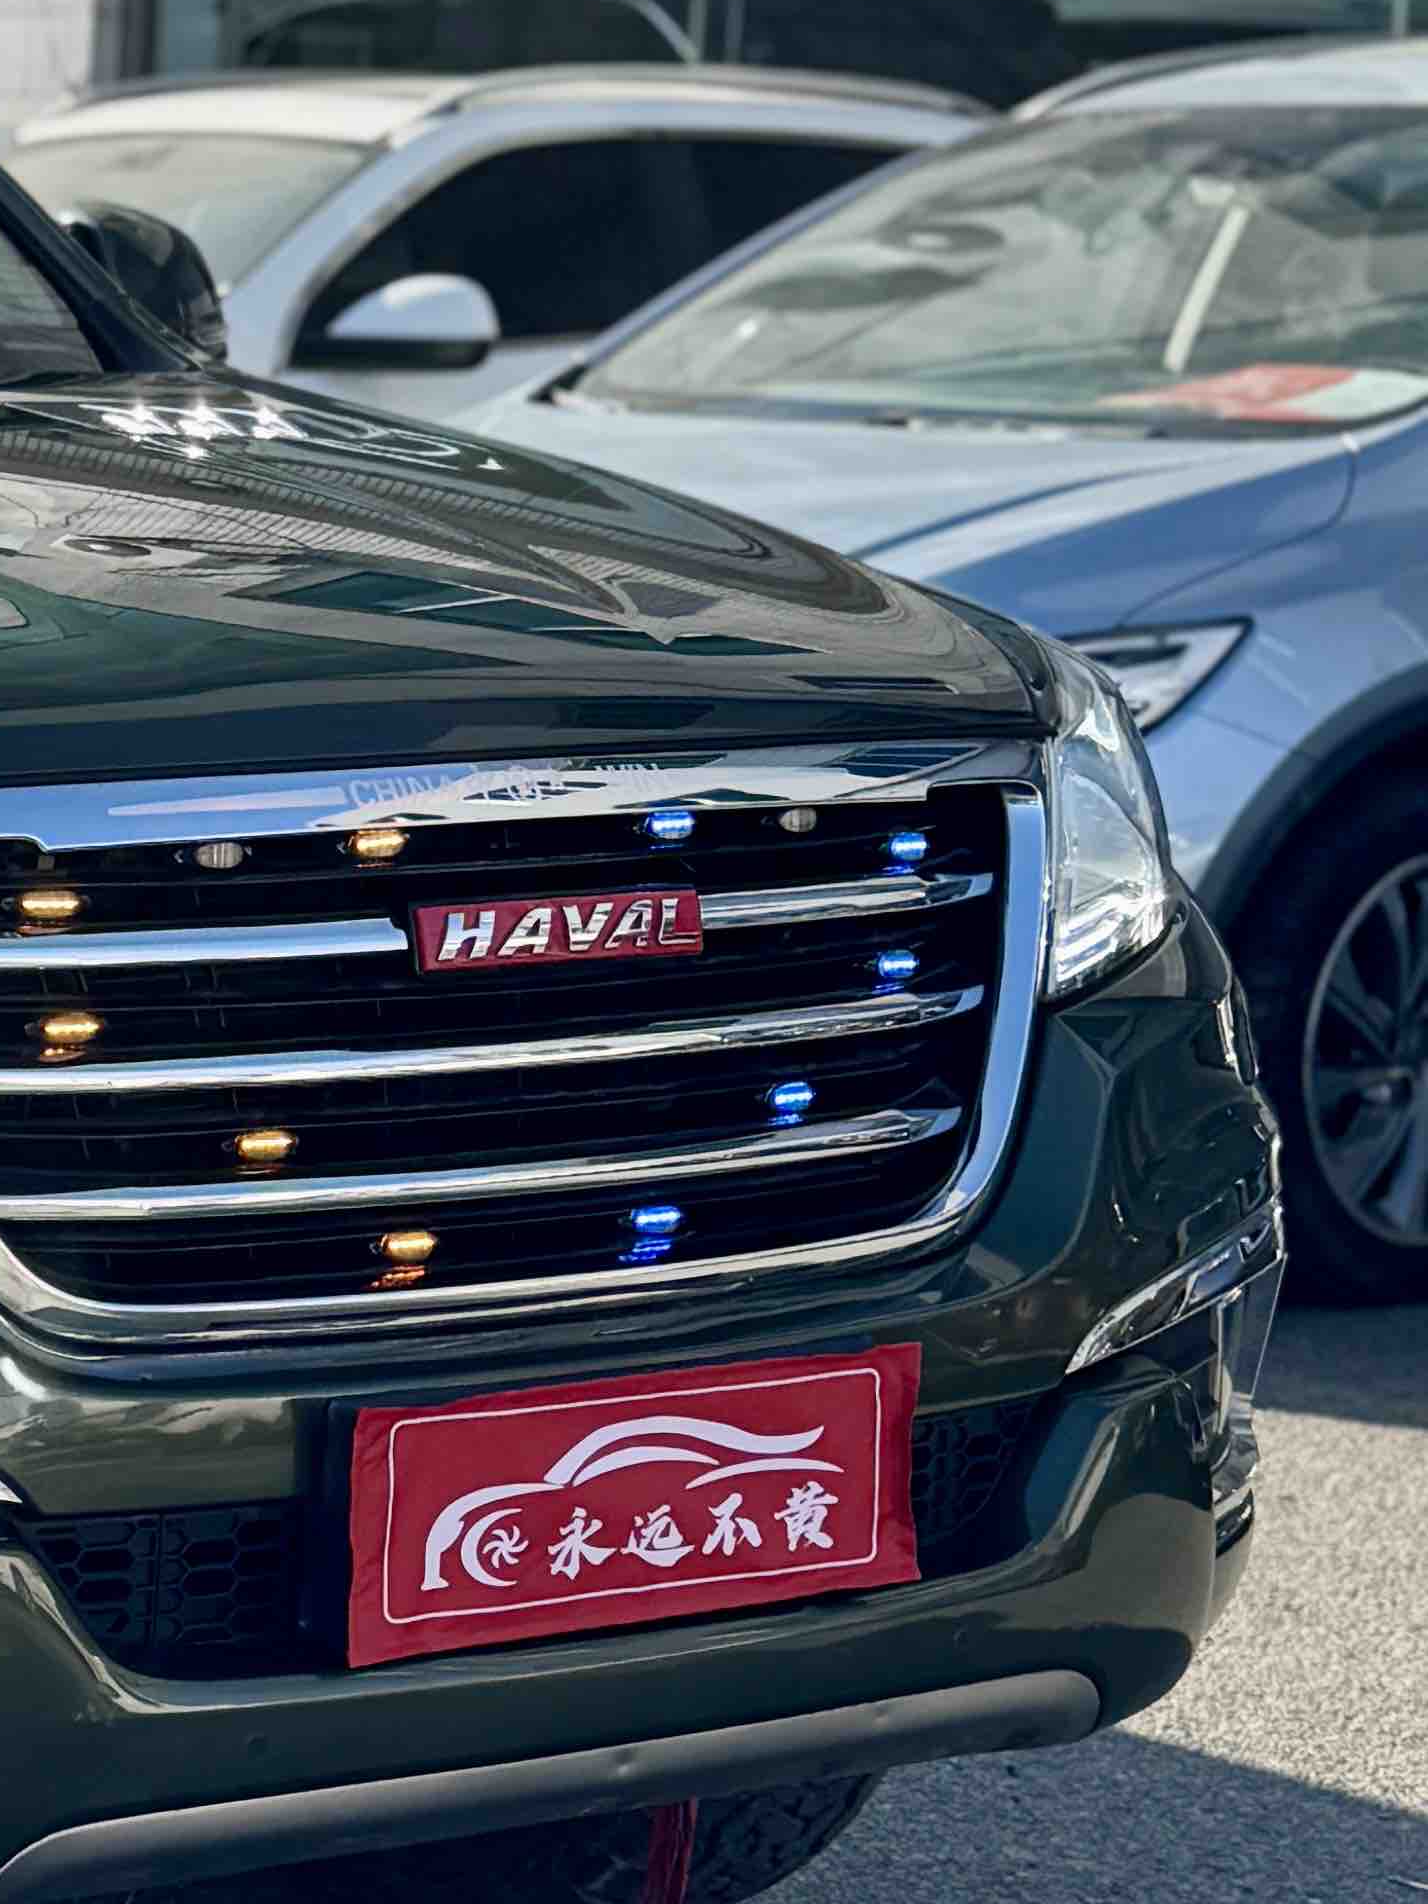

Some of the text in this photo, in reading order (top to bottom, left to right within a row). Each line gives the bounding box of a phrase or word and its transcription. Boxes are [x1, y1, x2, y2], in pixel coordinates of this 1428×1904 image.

[437, 897, 701, 962] HAVAL
[548, 1480, 840, 1580] 永远不黄
